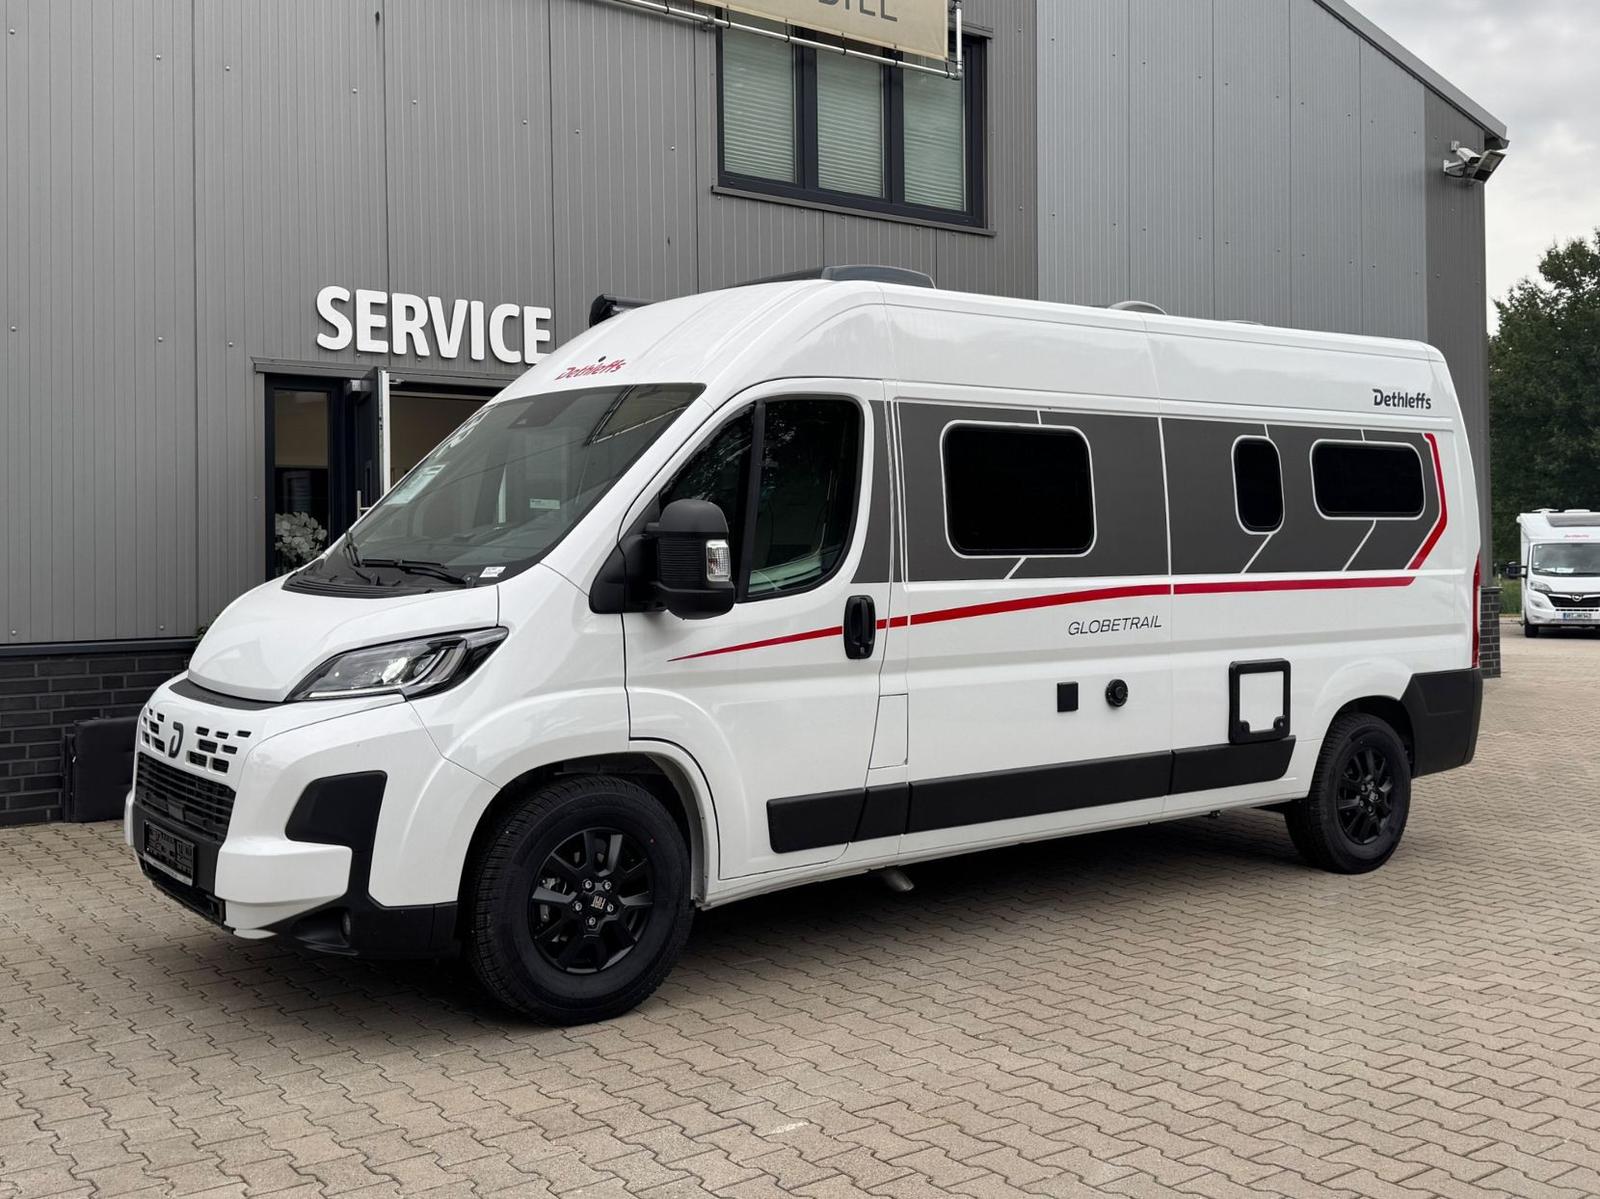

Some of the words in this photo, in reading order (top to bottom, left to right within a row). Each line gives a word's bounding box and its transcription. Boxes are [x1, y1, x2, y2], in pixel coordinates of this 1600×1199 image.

[316, 285, 552, 365] SERVICE
[1372, 388, 1432, 409] Dethleffs
[1068, 615, 1162, 636] GLOBETRAIL
